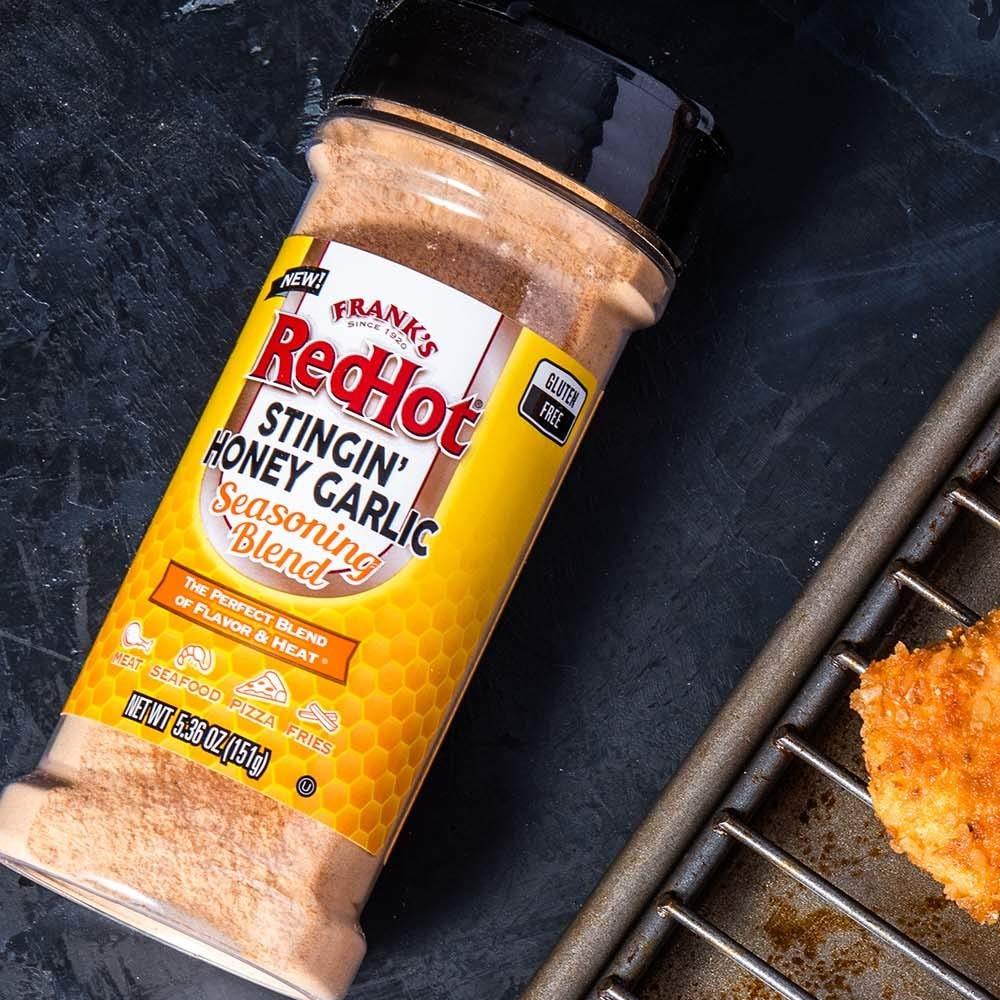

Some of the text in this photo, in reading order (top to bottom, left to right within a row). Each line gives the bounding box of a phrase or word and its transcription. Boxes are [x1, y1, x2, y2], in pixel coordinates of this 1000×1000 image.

[280, 271, 325, 290] NEW!
[332, 298, 438, 358] FRANK'S
[347, 320, 407, 350] SINCE 1920
[247, 311, 482, 458] RedHot
[539, 400, 565, 429] FREE
[545, 372, 580, 408] GLUTEN
[258, 402, 409, 487] STINGIN'
[203, 430, 439, 556] HONEY GARLIC
[211, 481, 382, 581] Seasoning
[231, 521, 329, 585] Blend
[254, 629, 269, 645] &
[111, 651, 334, 756] MEAT SEAFOOD PIZZA FRIES
[124, 693, 270, 778] NET WT 5.36 OZ (151g)
